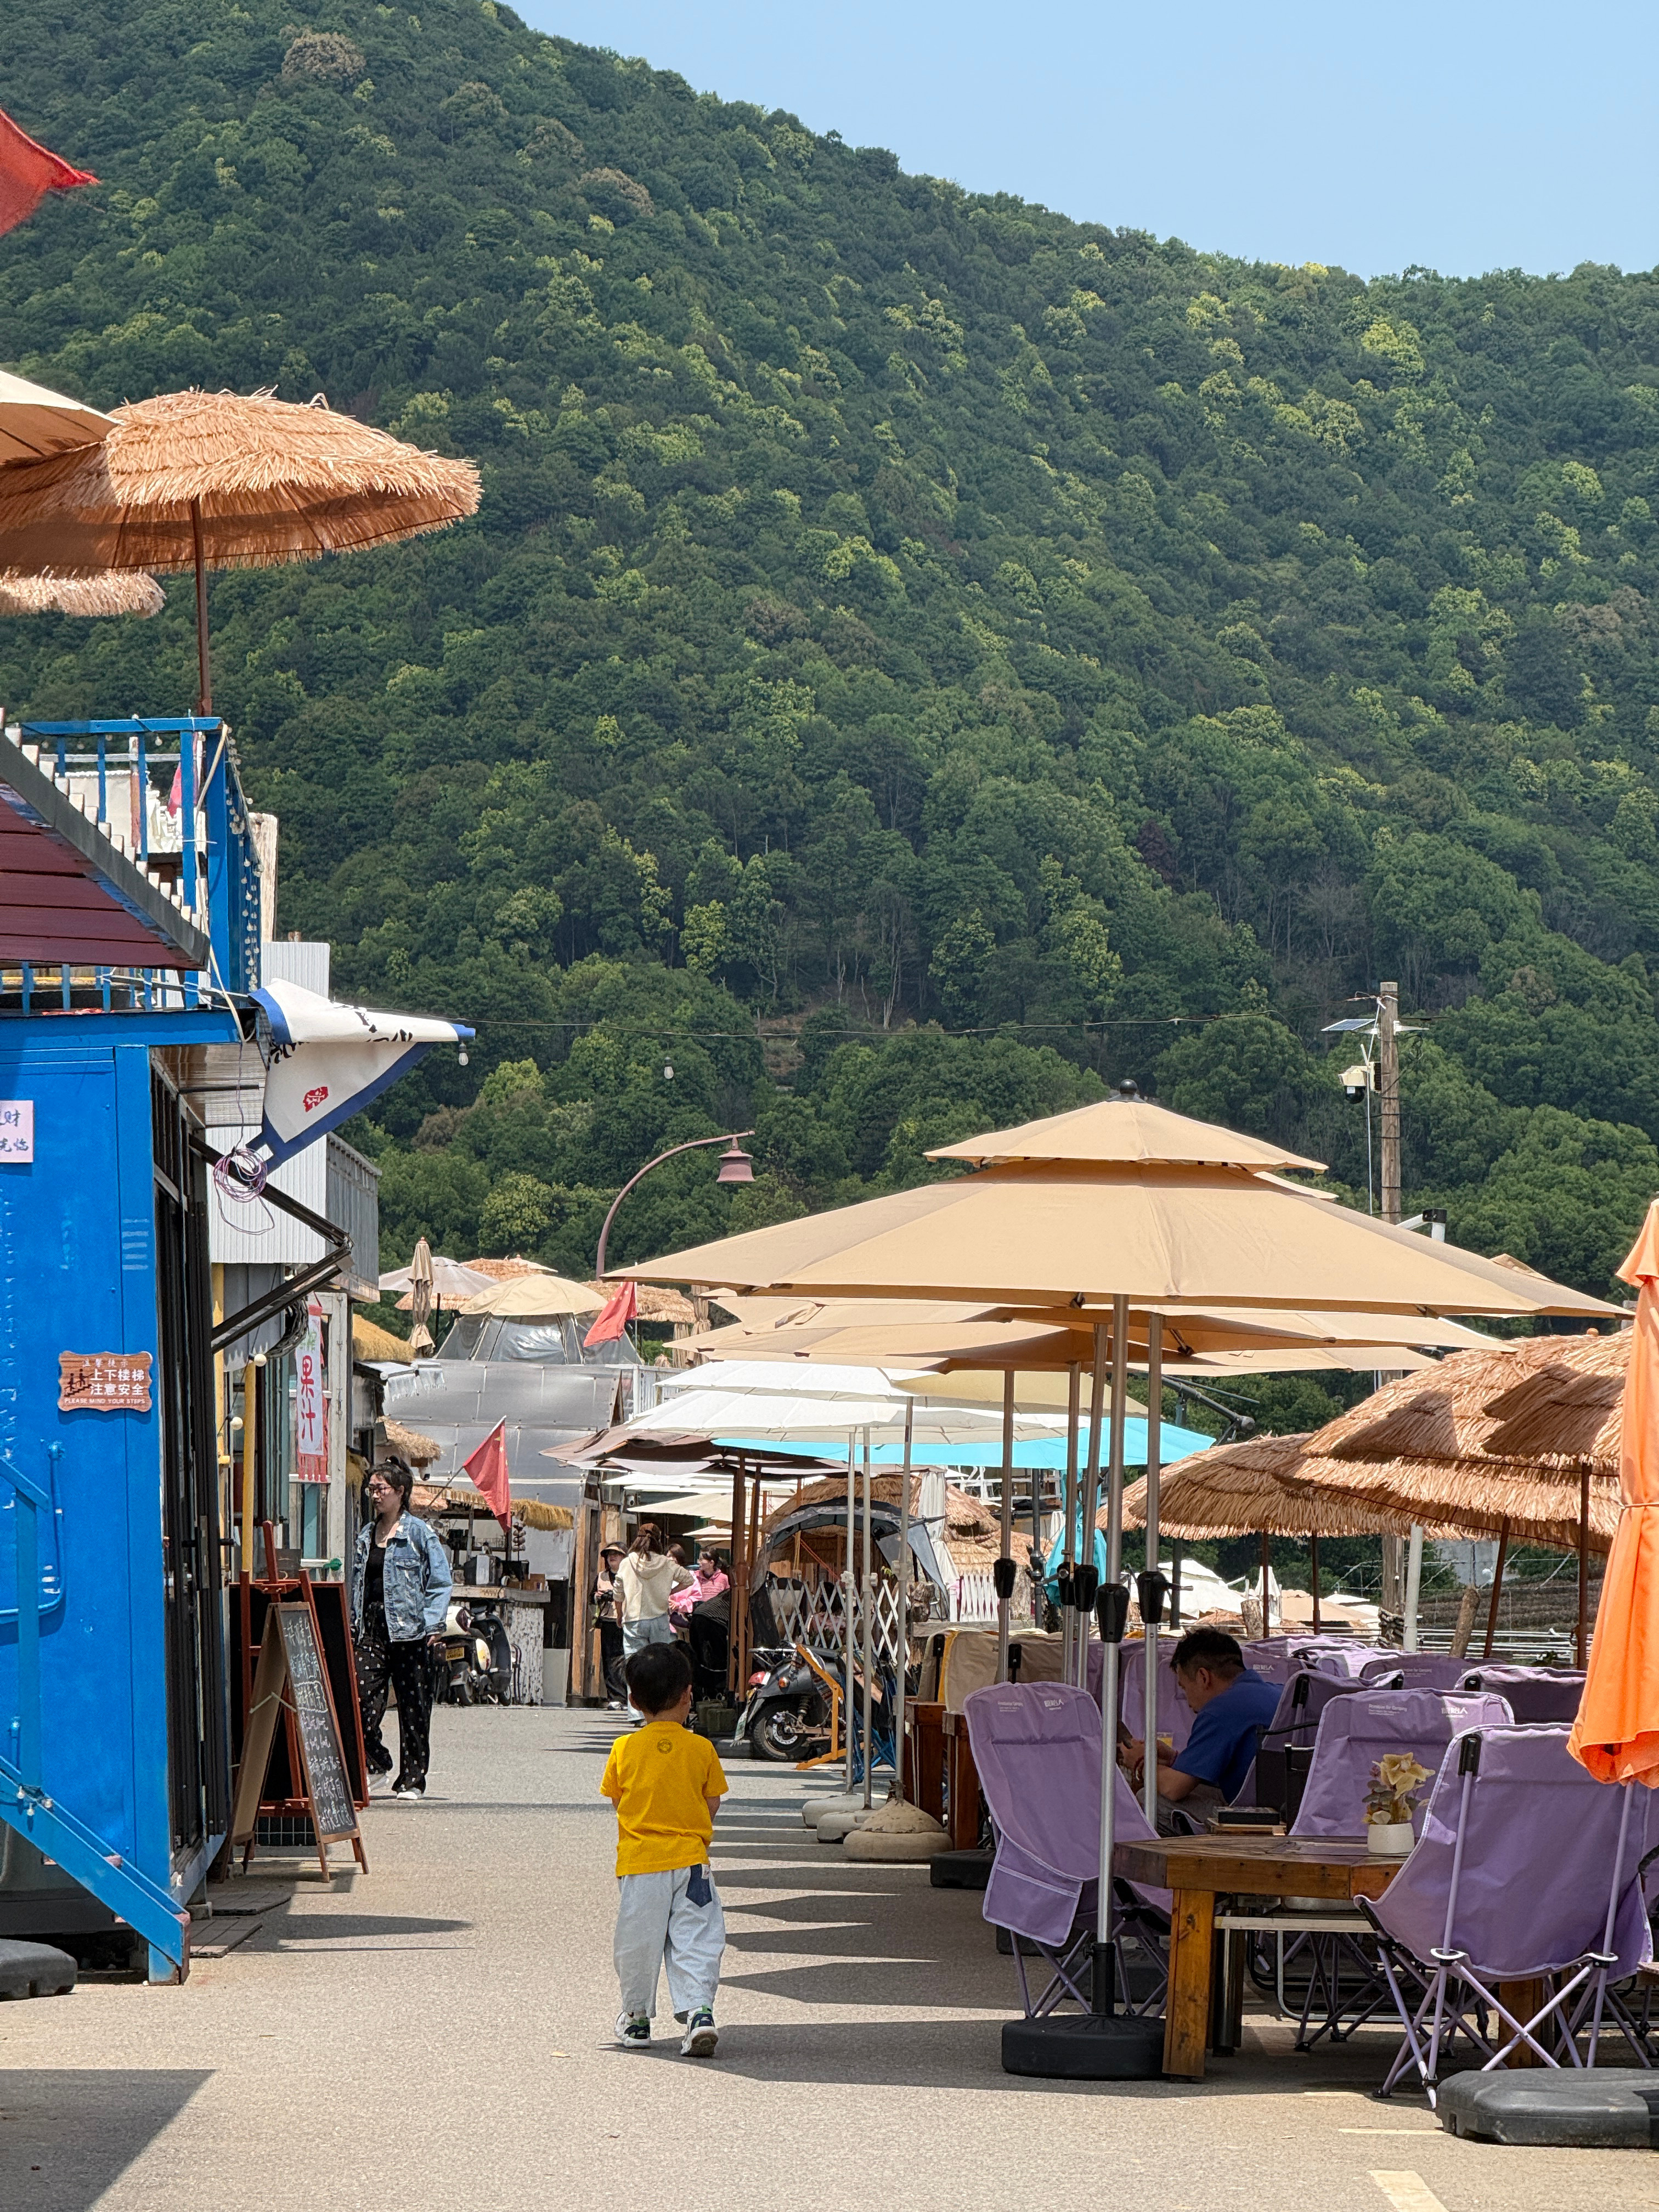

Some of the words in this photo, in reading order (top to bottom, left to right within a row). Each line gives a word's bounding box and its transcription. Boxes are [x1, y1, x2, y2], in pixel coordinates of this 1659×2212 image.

[90, 1368, 144, 1381] 上下楼梯
[90, 1383, 144, 1396] 注意安全
